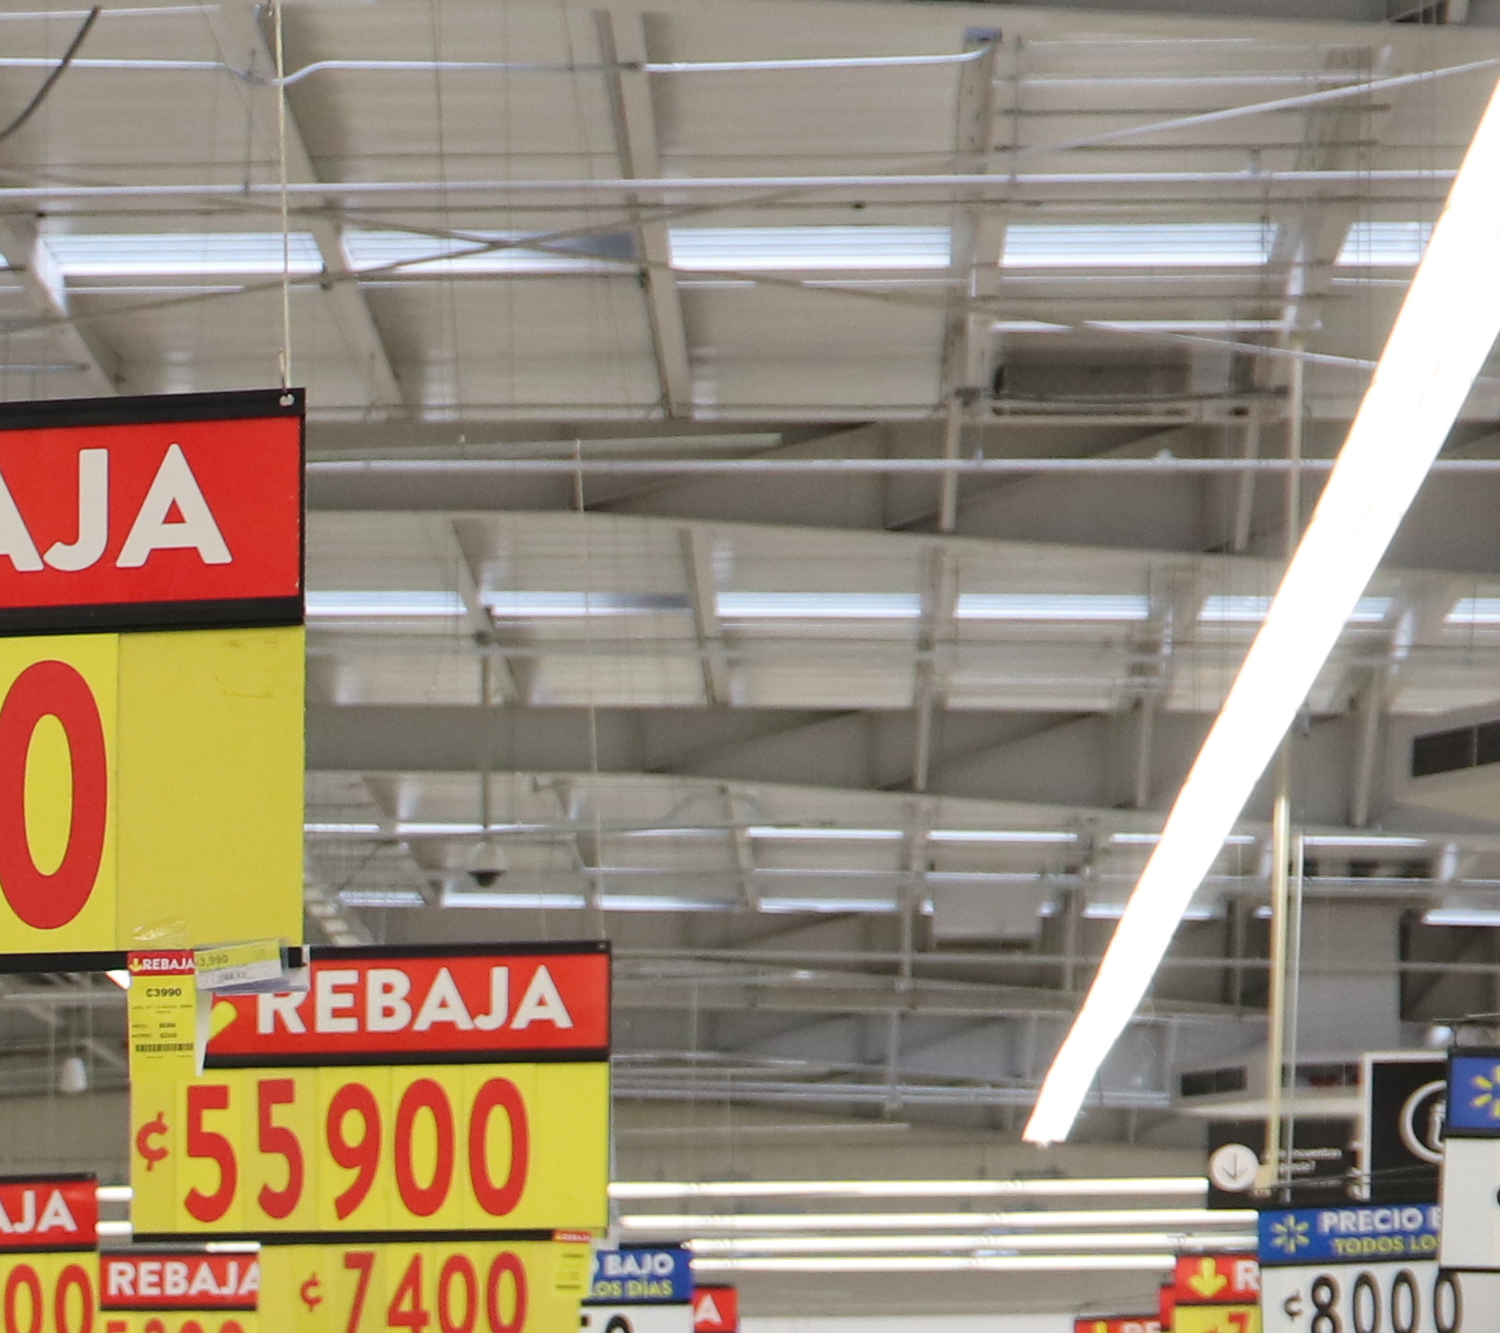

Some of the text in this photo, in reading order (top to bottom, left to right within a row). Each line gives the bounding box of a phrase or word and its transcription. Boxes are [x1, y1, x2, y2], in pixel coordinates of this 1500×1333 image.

[142, 958, 195, 970] REBAJA
[257, 964, 574, 1034] REBAJA
[136, 1077, 529, 1223] ¢55900
[1321, 1207, 1423, 1233] PRECIO
[1333, 1235, 1403, 1254] TODOS
[108, 1261, 260, 1297] REBAJA
